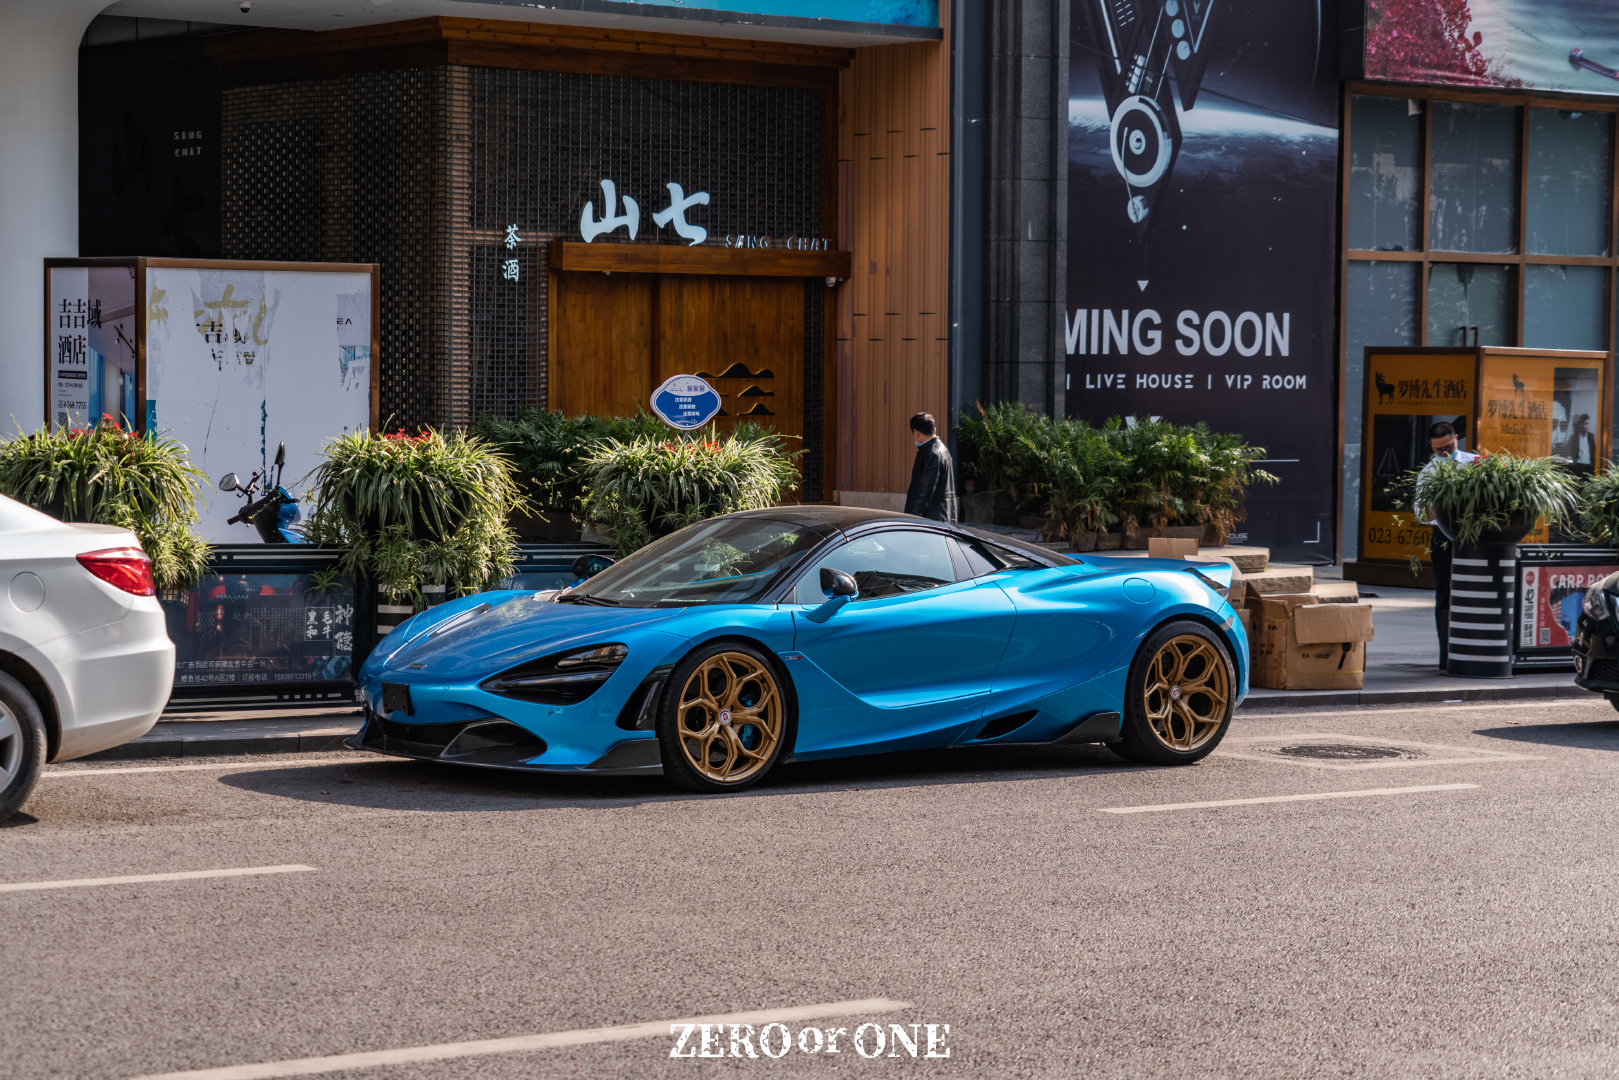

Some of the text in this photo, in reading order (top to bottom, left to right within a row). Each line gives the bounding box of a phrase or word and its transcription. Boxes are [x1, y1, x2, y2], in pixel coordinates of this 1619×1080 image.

[173, 130, 203, 141] SANG
[579, 178, 711, 247] 山七
[725, 234, 831, 251] SANG CHAT
[1175, 309, 1291, 357] SOON
[58, 334, 87, 365] 酒店
[1085, 373, 1307, 390] LIVE HOUSE VIP ROOM
[1397, 379, 1467, 399] 罗博先生酒店
[1368, 527, 1431, 546] 023-6760
[1550, 574, 1584, 589] CARP
